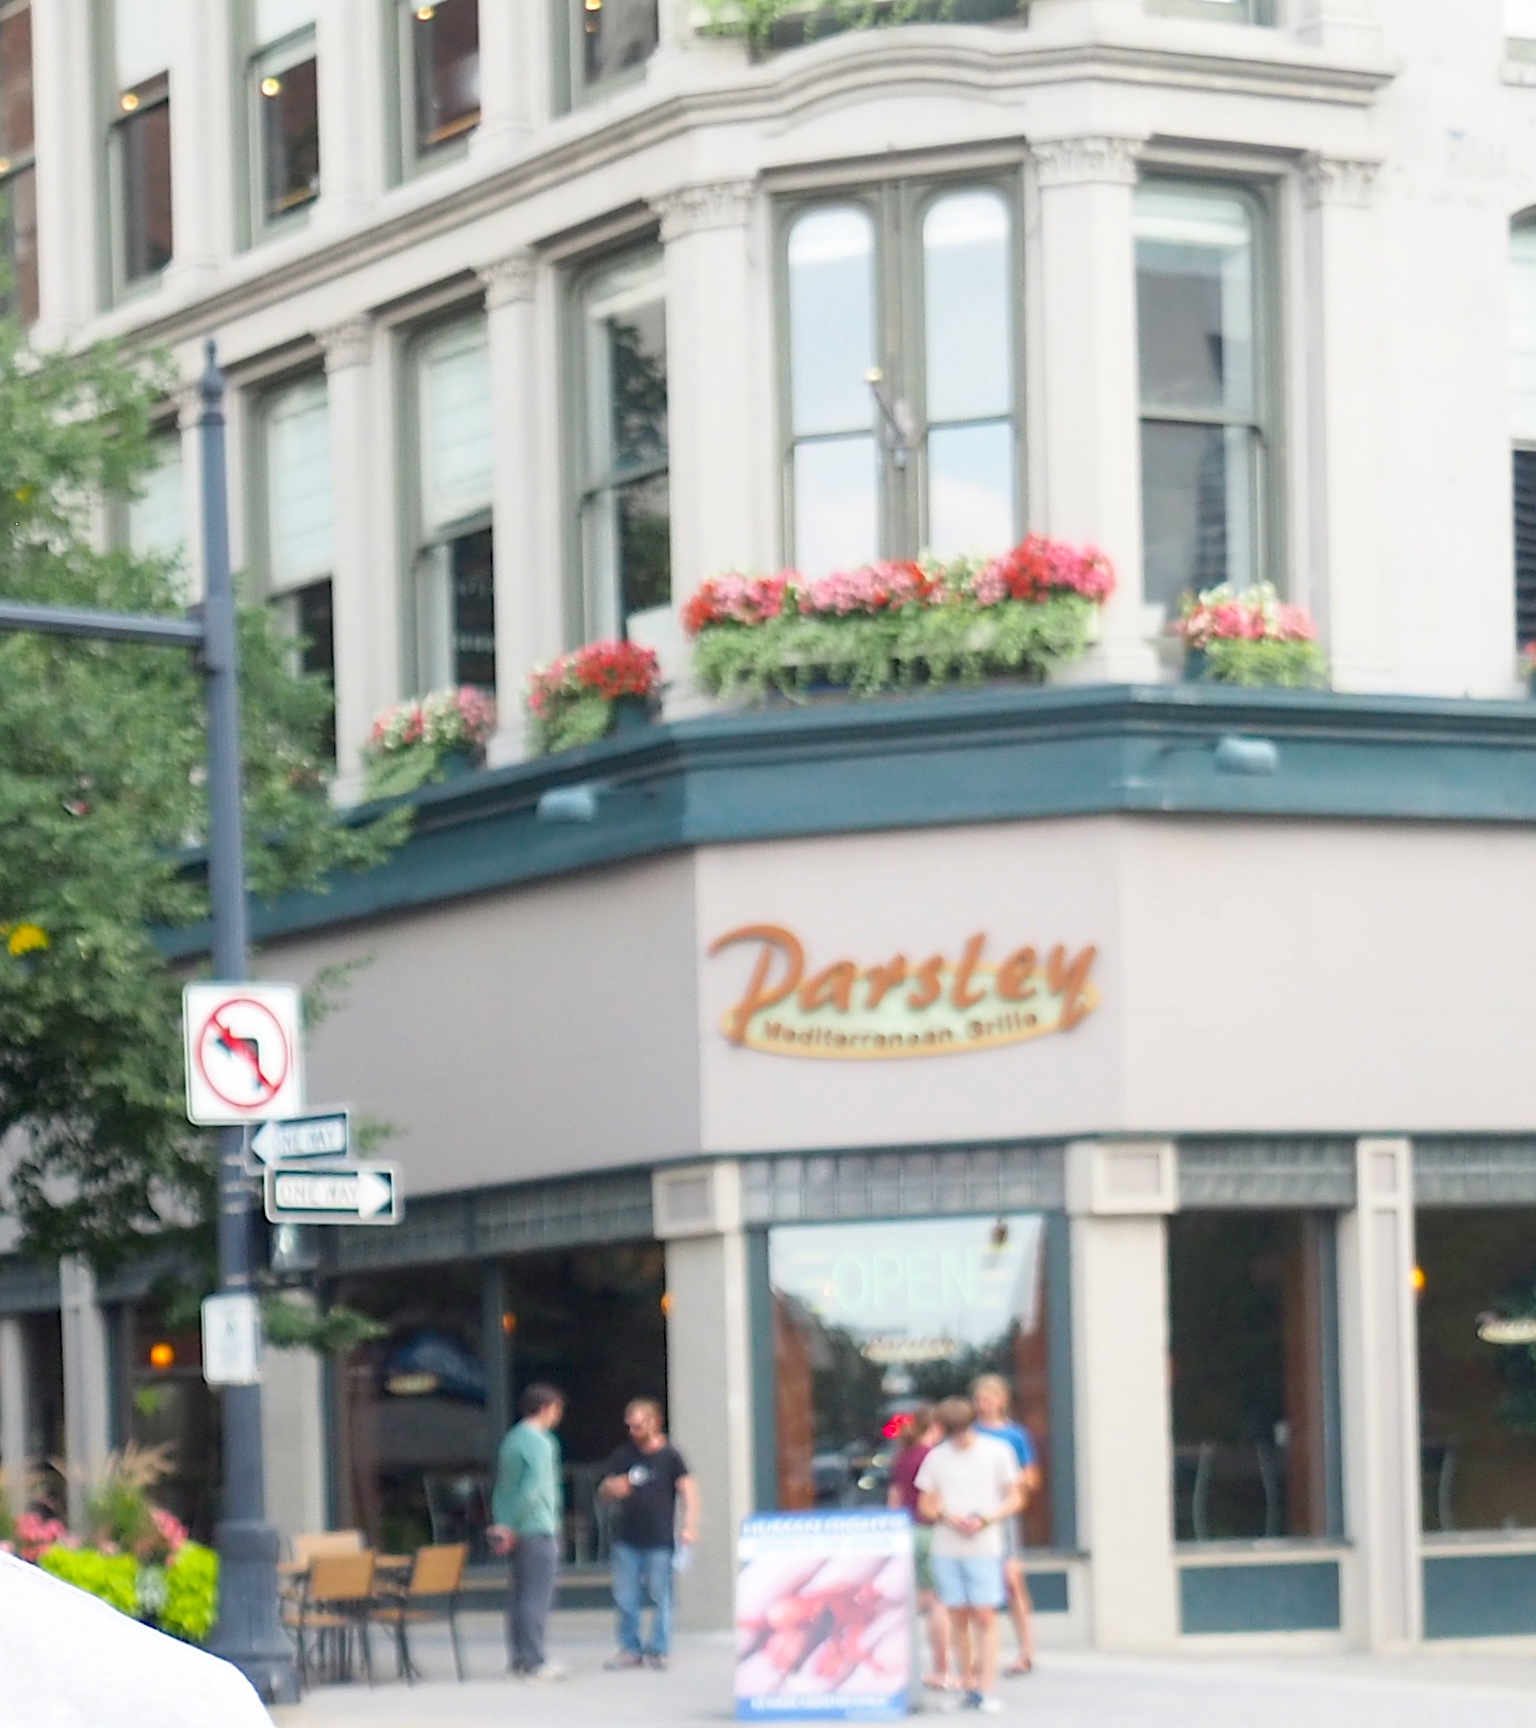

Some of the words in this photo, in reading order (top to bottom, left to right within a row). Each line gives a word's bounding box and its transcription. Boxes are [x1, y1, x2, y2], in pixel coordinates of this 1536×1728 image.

[708, 923, 1097, 1046] Parsley
[762, 1017, 954, 1050] Mediterranean
[280, 1183, 314, 1205] ONE
[326, 1183, 356, 1205] WAY
[832, 1248, 976, 1312] OPEN
